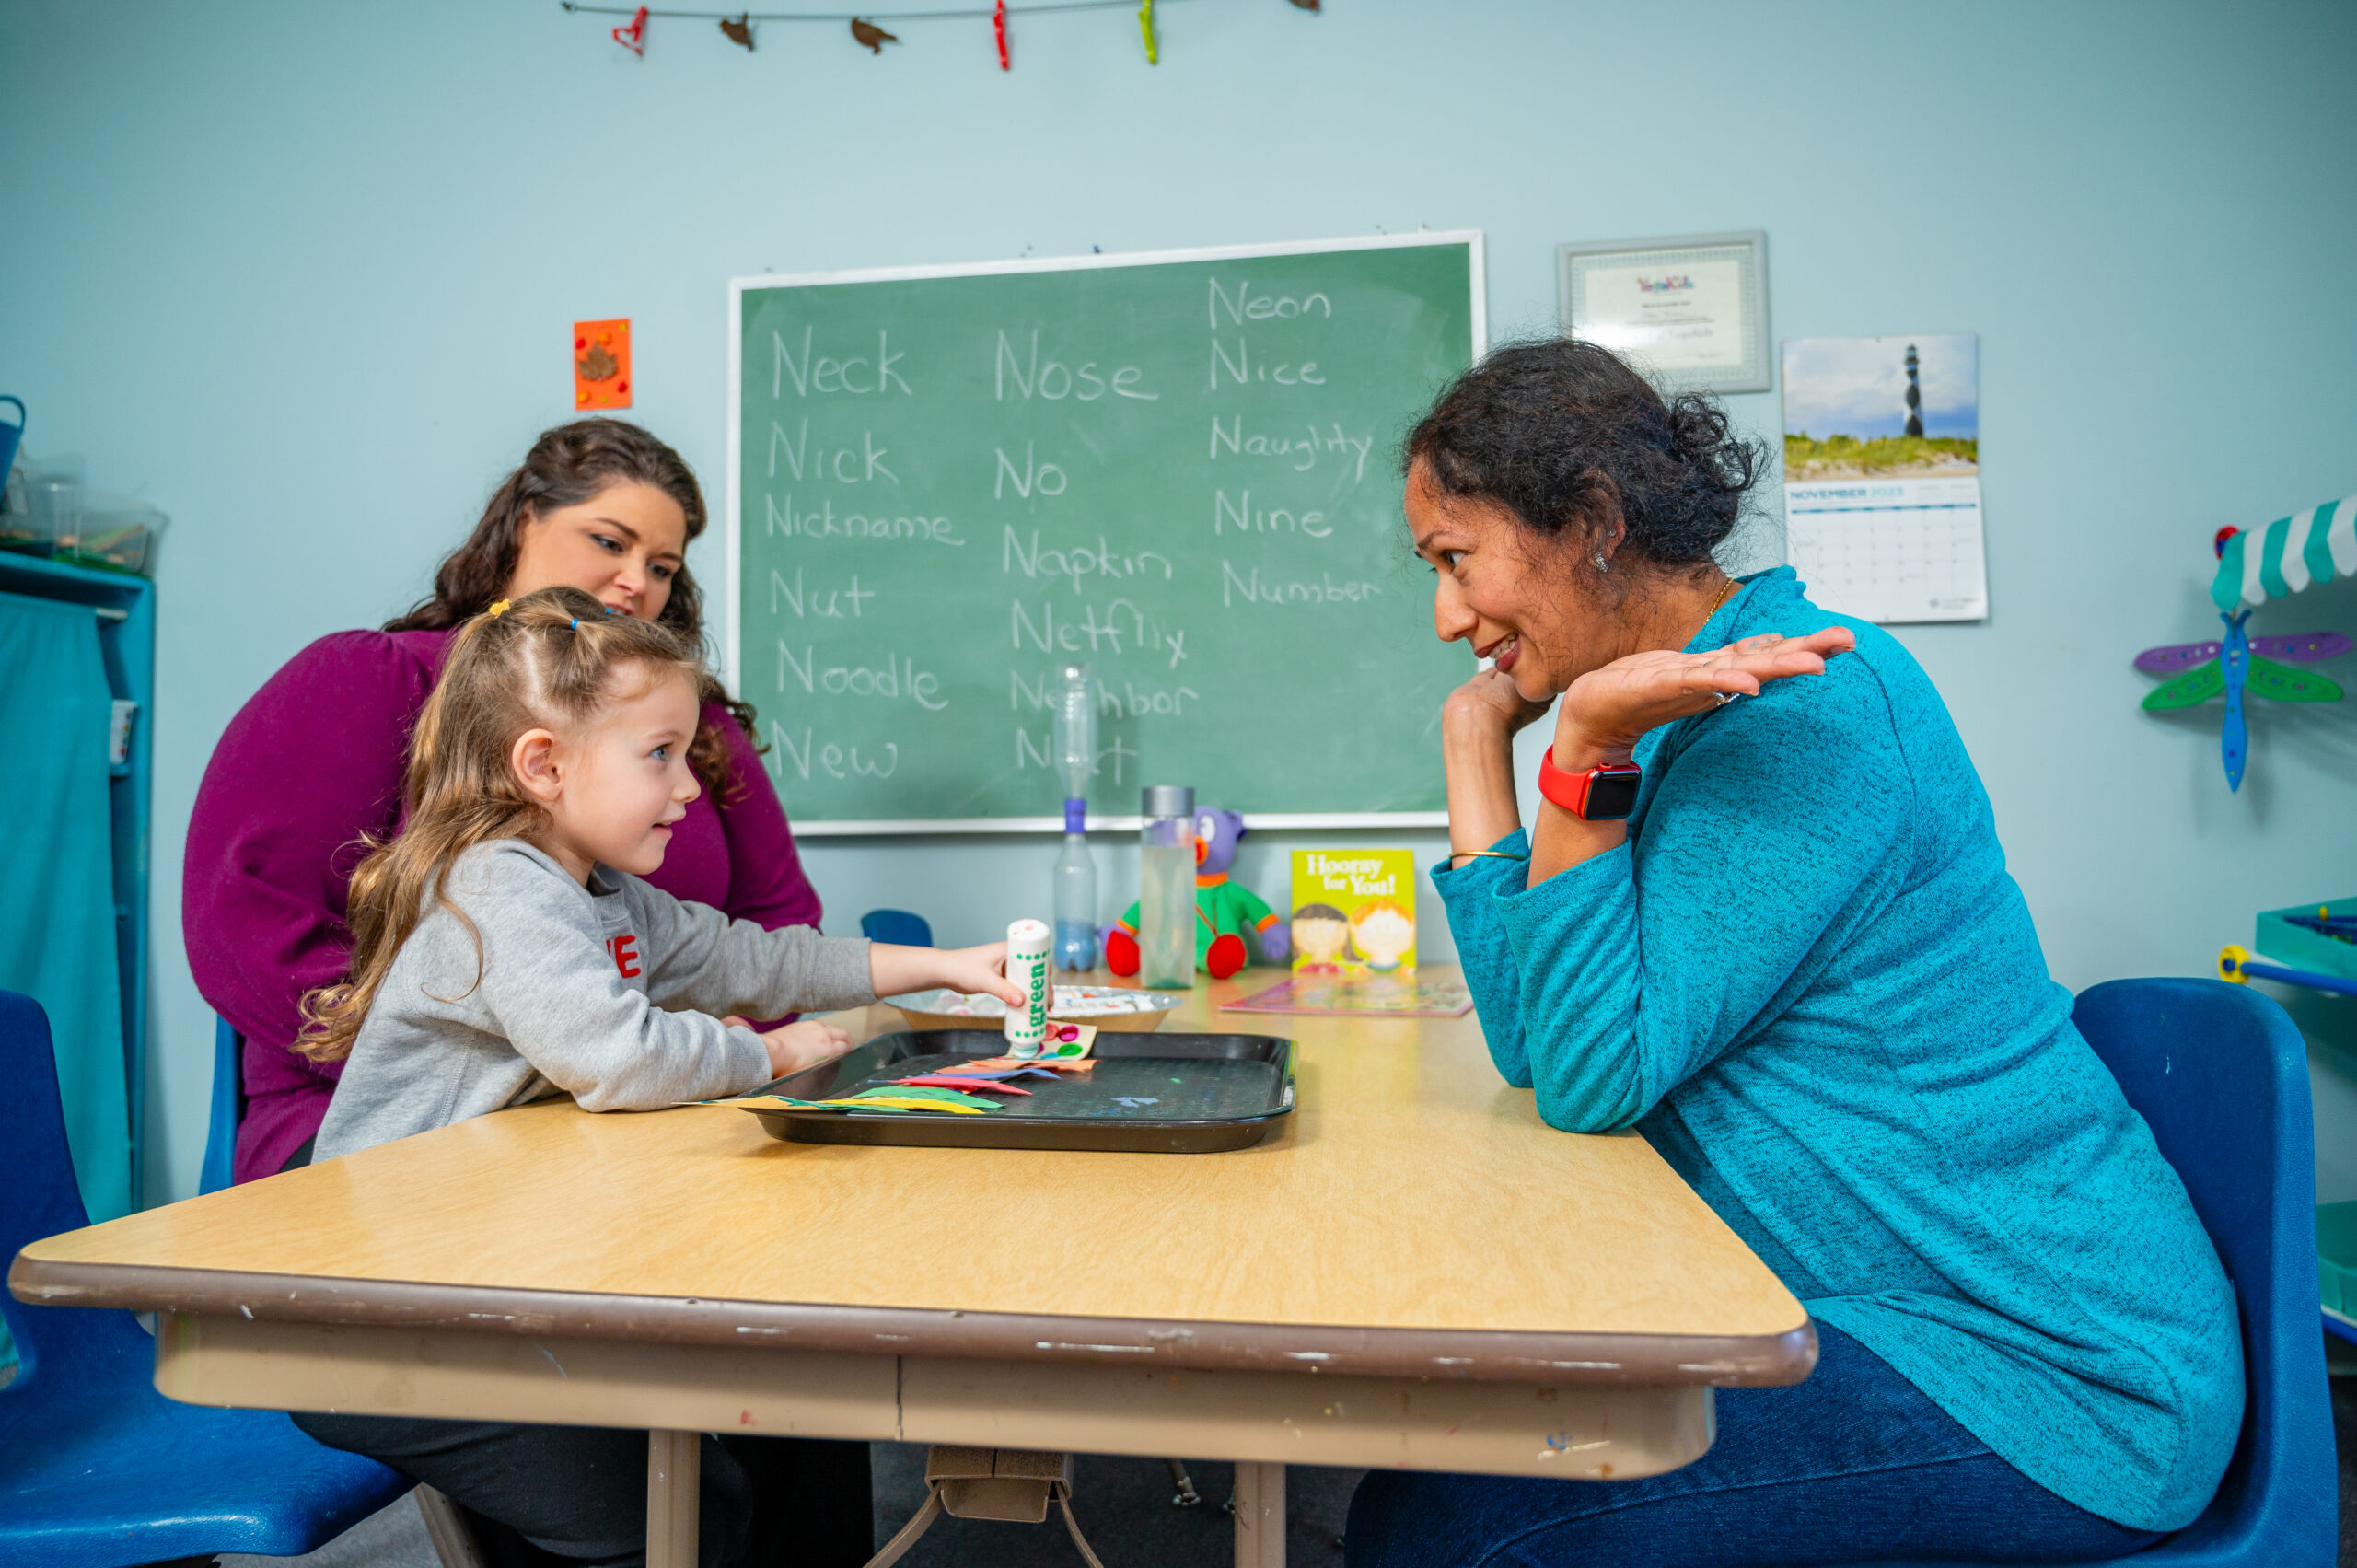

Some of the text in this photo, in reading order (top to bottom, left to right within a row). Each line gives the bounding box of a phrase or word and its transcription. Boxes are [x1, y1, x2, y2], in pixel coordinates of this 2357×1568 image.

[1209, 277, 1331, 330] Neon
[772, 325, 913, 400] Neck
[995, 329, 1160, 401] Nose
[1210, 337, 1327, 390] Nice
[768, 417, 900, 485] Nick
[995, 439, 1068, 500] No
[1210, 414, 1373, 484] Naughty
[766, 492, 966, 545] Nickname
[1214, 488, 1333, 538] Nine
[1790, 488, 1867, 500] NOVEMBER
[1003, 523, 1173, 597] Napkin
[1222, 559, 1381, 608] Number
[771, 566, 877, 618] Nut
[1013, 598, 1189, 669] Netflix
[776, 638, 949, 711] Noodle
[1009, 668, 1199, 720] Nehbor
[771, 718, 899, 780] New
[1016, 726, 1139, 787] Nt
[1306, 854, 1383, 879] Hooray
[1323, 874, 1396, 896] for You!
[1029, 961, 1045, 1028] green
